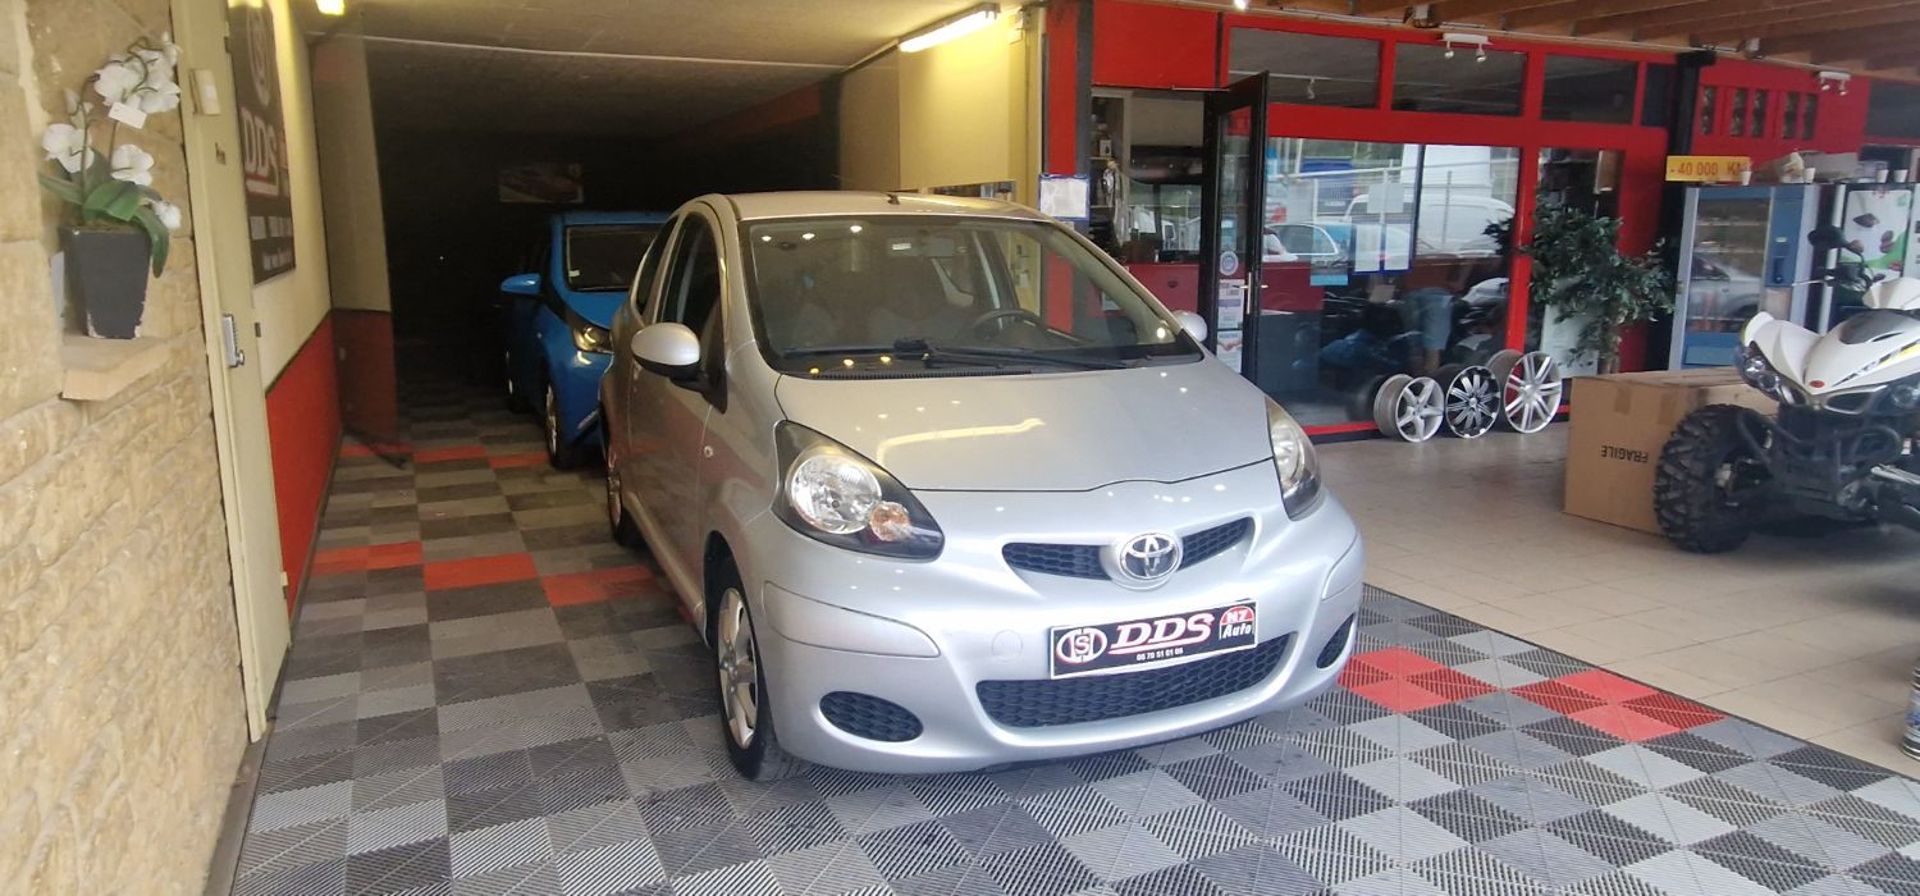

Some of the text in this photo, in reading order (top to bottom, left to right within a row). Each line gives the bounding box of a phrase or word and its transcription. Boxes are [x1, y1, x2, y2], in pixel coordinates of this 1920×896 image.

[241, 108, 280, 180] DDS
[1678, 162, 1693, 175] 40
[1697, 162, 1718, 176] 000
[1600, 445, 1649, 463] FRAGILE
[1110, 613, 1215, 650] DDS
[1222, 623, 1252, 639] Auto
